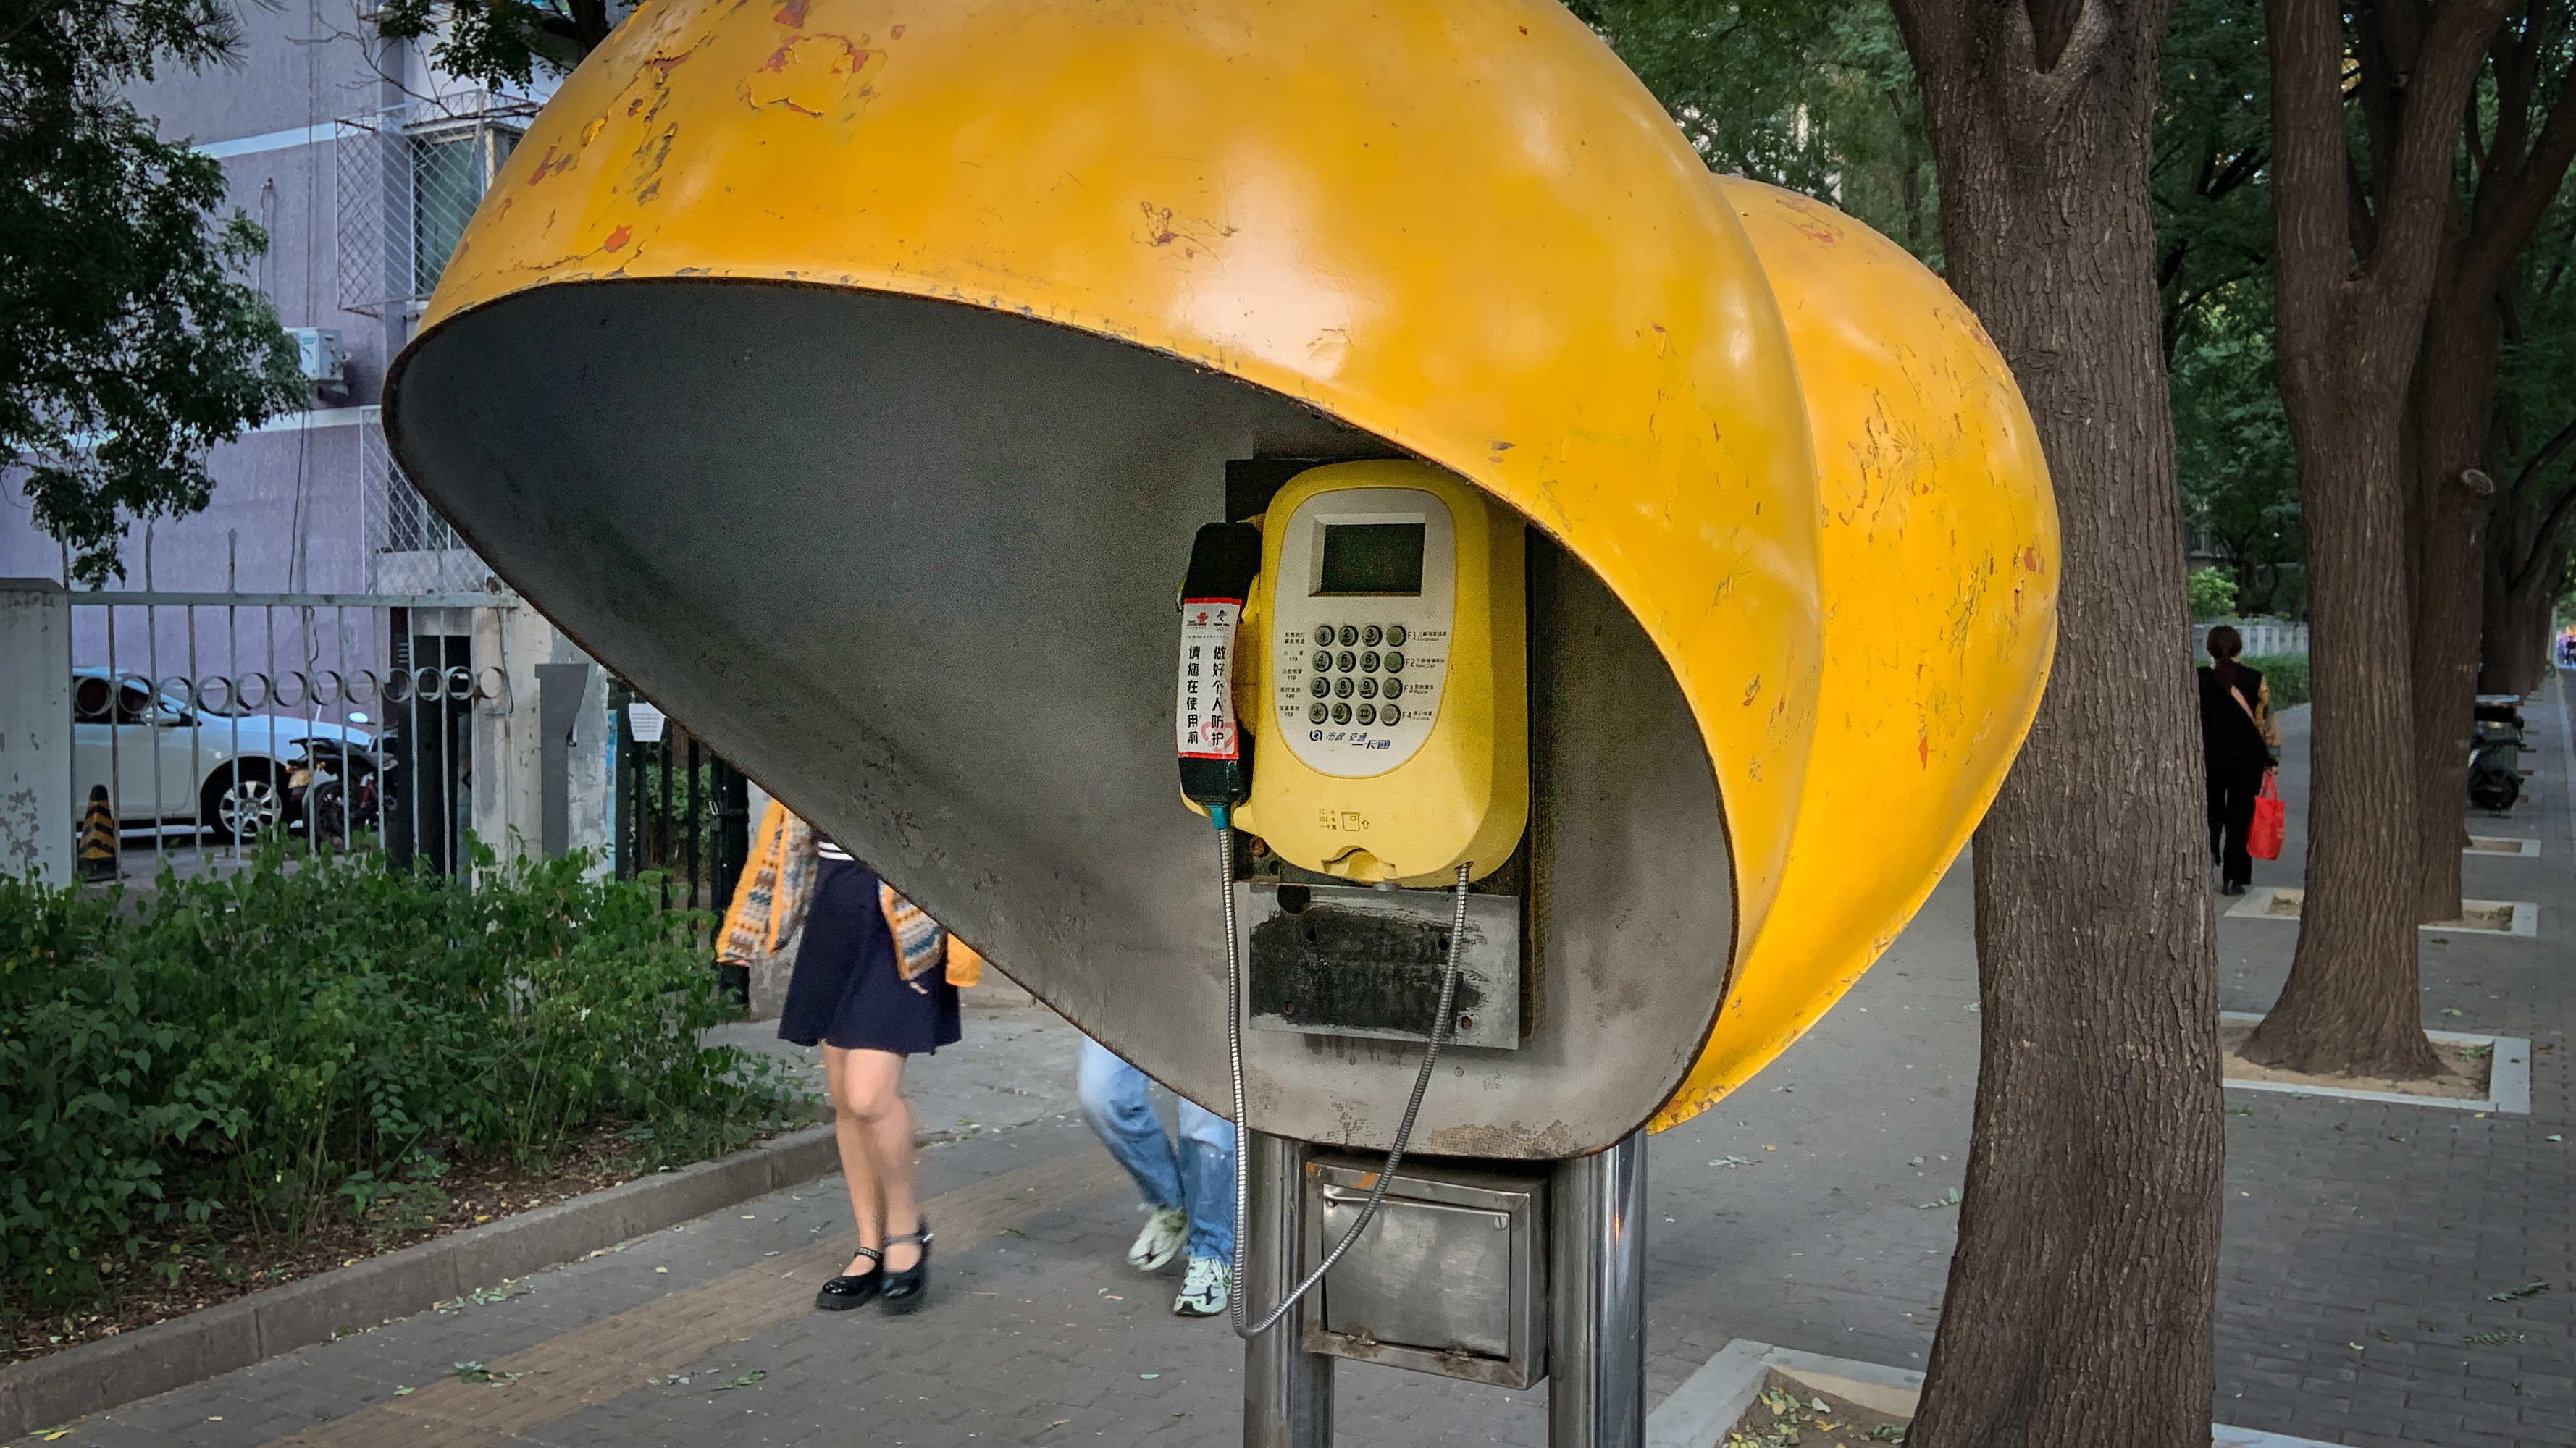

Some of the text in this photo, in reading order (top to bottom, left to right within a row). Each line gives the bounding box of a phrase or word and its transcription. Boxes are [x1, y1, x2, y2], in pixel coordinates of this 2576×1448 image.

[1343, 628, 1350, 638] 2
[1367, 628, 1374, 638] 3
[1407, 631, 1416, 640] F1
[1318, 654, 1324, 662] 4
[1341, 654, 1347, 663] 5
[1365, 654, 1372, 663] 6
[1406, 658, 1415, 667] F2
[1316, 680, 1322, 689] 7
[1340, 681, 1346, 689] 8
[1364, 681, 1369, 689] 9
[1404, 684, 1413, 693] F3
[1186, 645, 1201, 744] 请您在使用前
[1211, 645, 1226, 746] 做好个人防护
